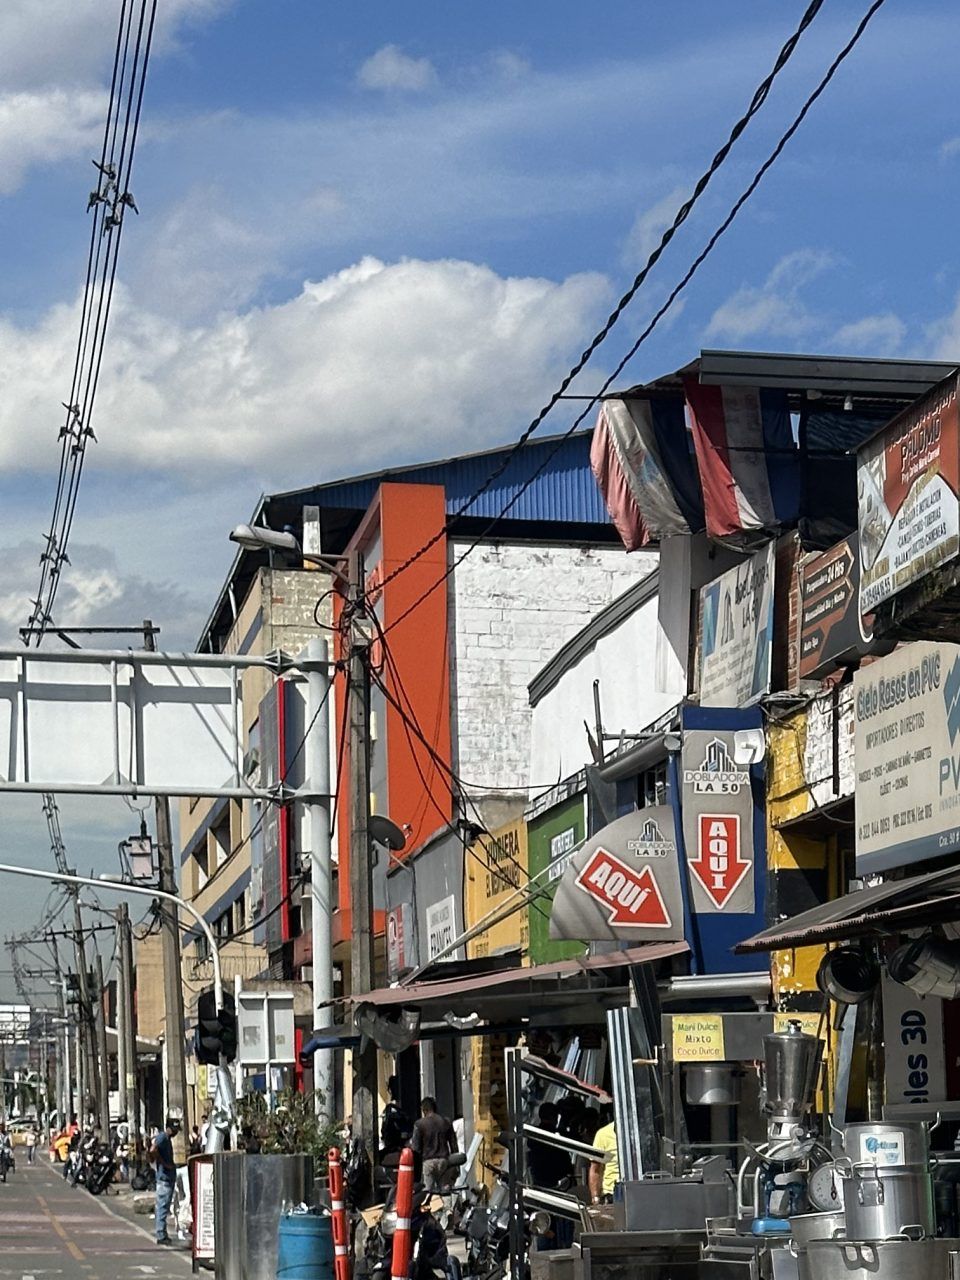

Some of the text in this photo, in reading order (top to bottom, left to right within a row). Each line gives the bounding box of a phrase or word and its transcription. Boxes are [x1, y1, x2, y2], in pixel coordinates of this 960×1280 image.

[827, 564, 835, 584] 24
[835, 560, 845, 579] Hrs
[857, 650, 941, 722] Cielo Rasos en PVC
[865, 711, 925, 750] IMPORTADORES DIRECTOS
[685, 771, 750, 783] DOBLADORA
[696, 782, 738, 793] LA 50
[628, 841, 674, 850] DOBLADORA
[708, 821, 728, 889] AQUI
[588, 861, 651, 914] AQUÍ
[697, 1022, 719, 1031] Dulce
[685, 1034, 712, 1043] Mixto
[677, 1047, 720, 1056] Coco Dulce
[901, 1009, 929, 1104] les 3D
